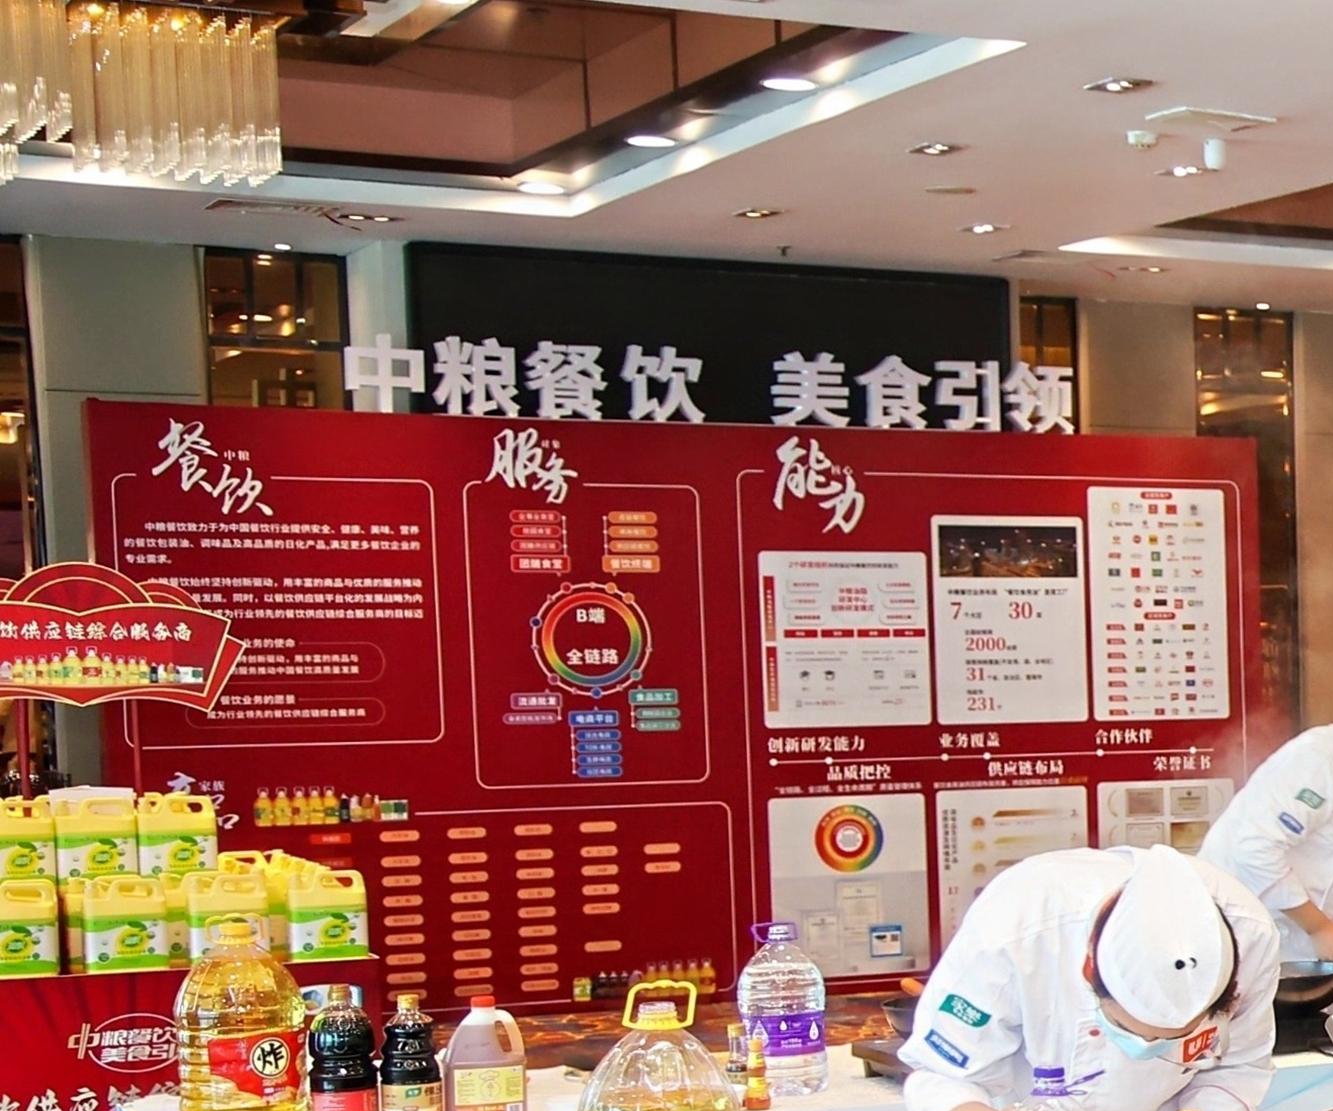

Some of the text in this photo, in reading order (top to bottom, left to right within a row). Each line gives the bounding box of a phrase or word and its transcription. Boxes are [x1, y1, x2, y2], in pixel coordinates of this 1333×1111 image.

[343, 333, 1076, 434] 中粮餐饮 美食引领
[485, 428, 578, 504] 服务
[576, 607, 606, 624] B端
[950, 601, 963, 620] 7
[1008, 601, 1033, 620] 30
[965, 637, 1007, 652] 2000
[566, 648, 620, 665] 全链路
[966, 667, 986, 682] 31
[967, 697, 996, 712] 231
[767, 735, 866, 754] 创新研发能力
[939, 730, 1001, 749] 业务覆盖
[1095, 728, 1153, 744] 合作伙伴
[988, 760, 1065, 777] 供应链布局
[1153, 755, 1212, 771] 荣誉证书
[826, 764, 892, 782] 品质把控
[100, 1042, 178, 1064] 美食引
[257, 1041, 286, 1074] 炸
